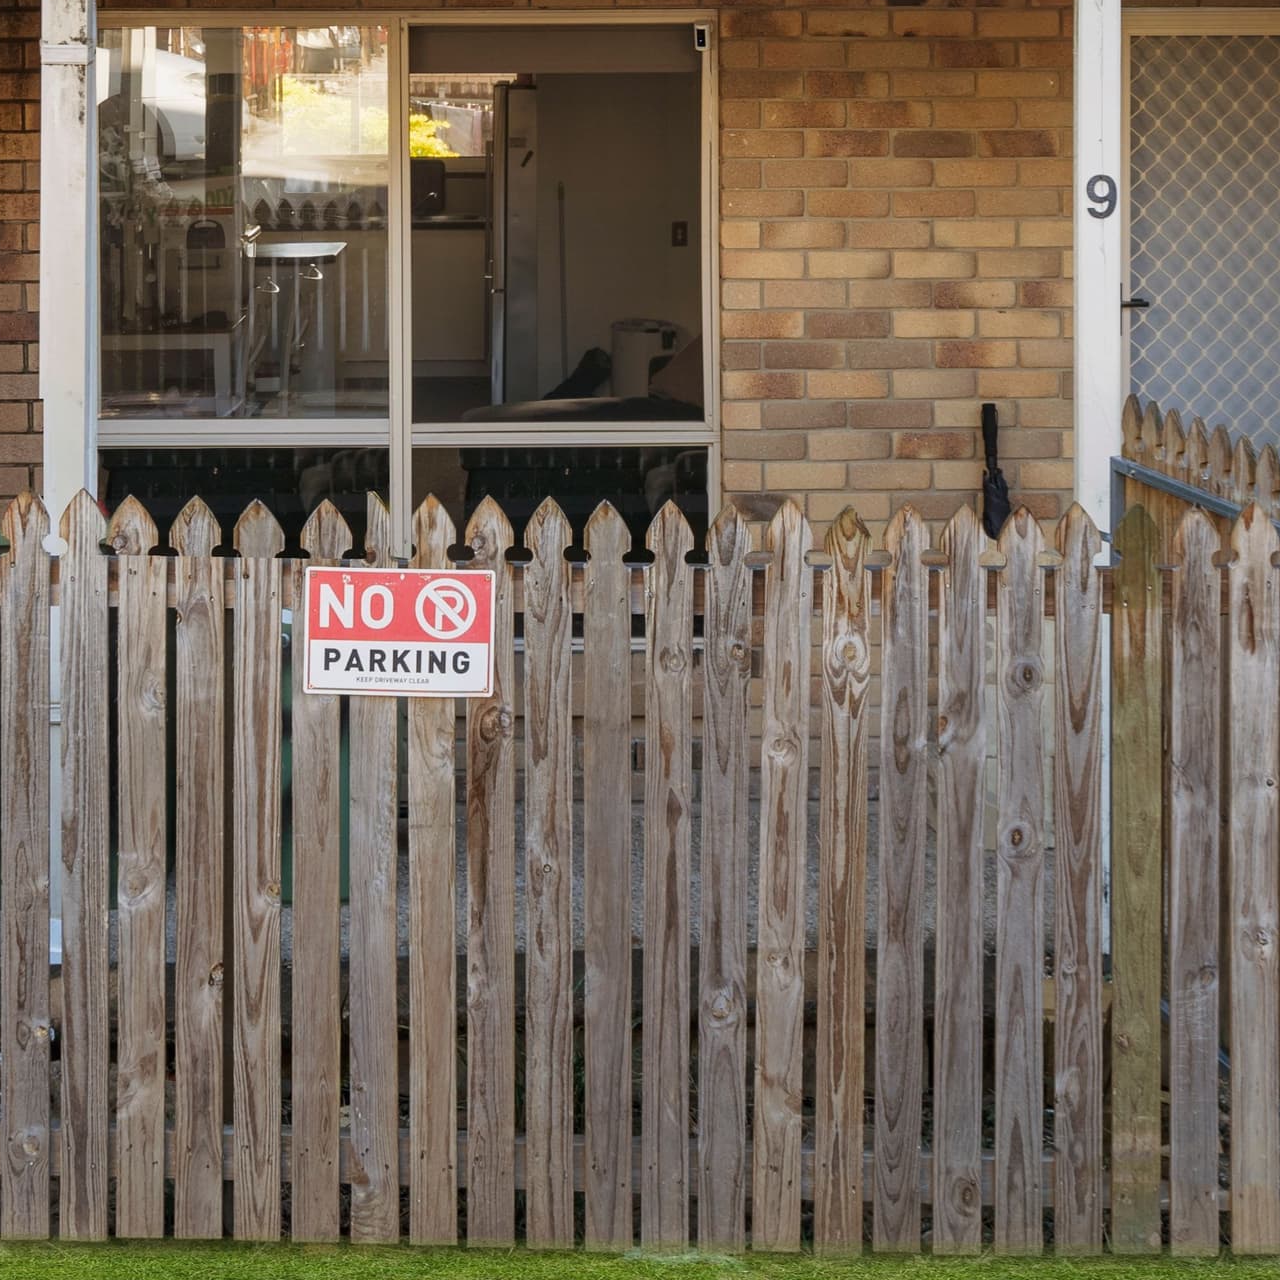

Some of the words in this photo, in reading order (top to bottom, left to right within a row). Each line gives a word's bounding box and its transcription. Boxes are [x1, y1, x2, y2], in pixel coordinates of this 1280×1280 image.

[1086, 174, 1117, 219] 9
[319, 583, 394, 629] NO
[324, 648, 470, 674] PARKING
[356, 676, 373, 684] KEEP
[375, 676, 407, 685] DRIVEWAY
[409, 677, 429, 685] CLEAR
